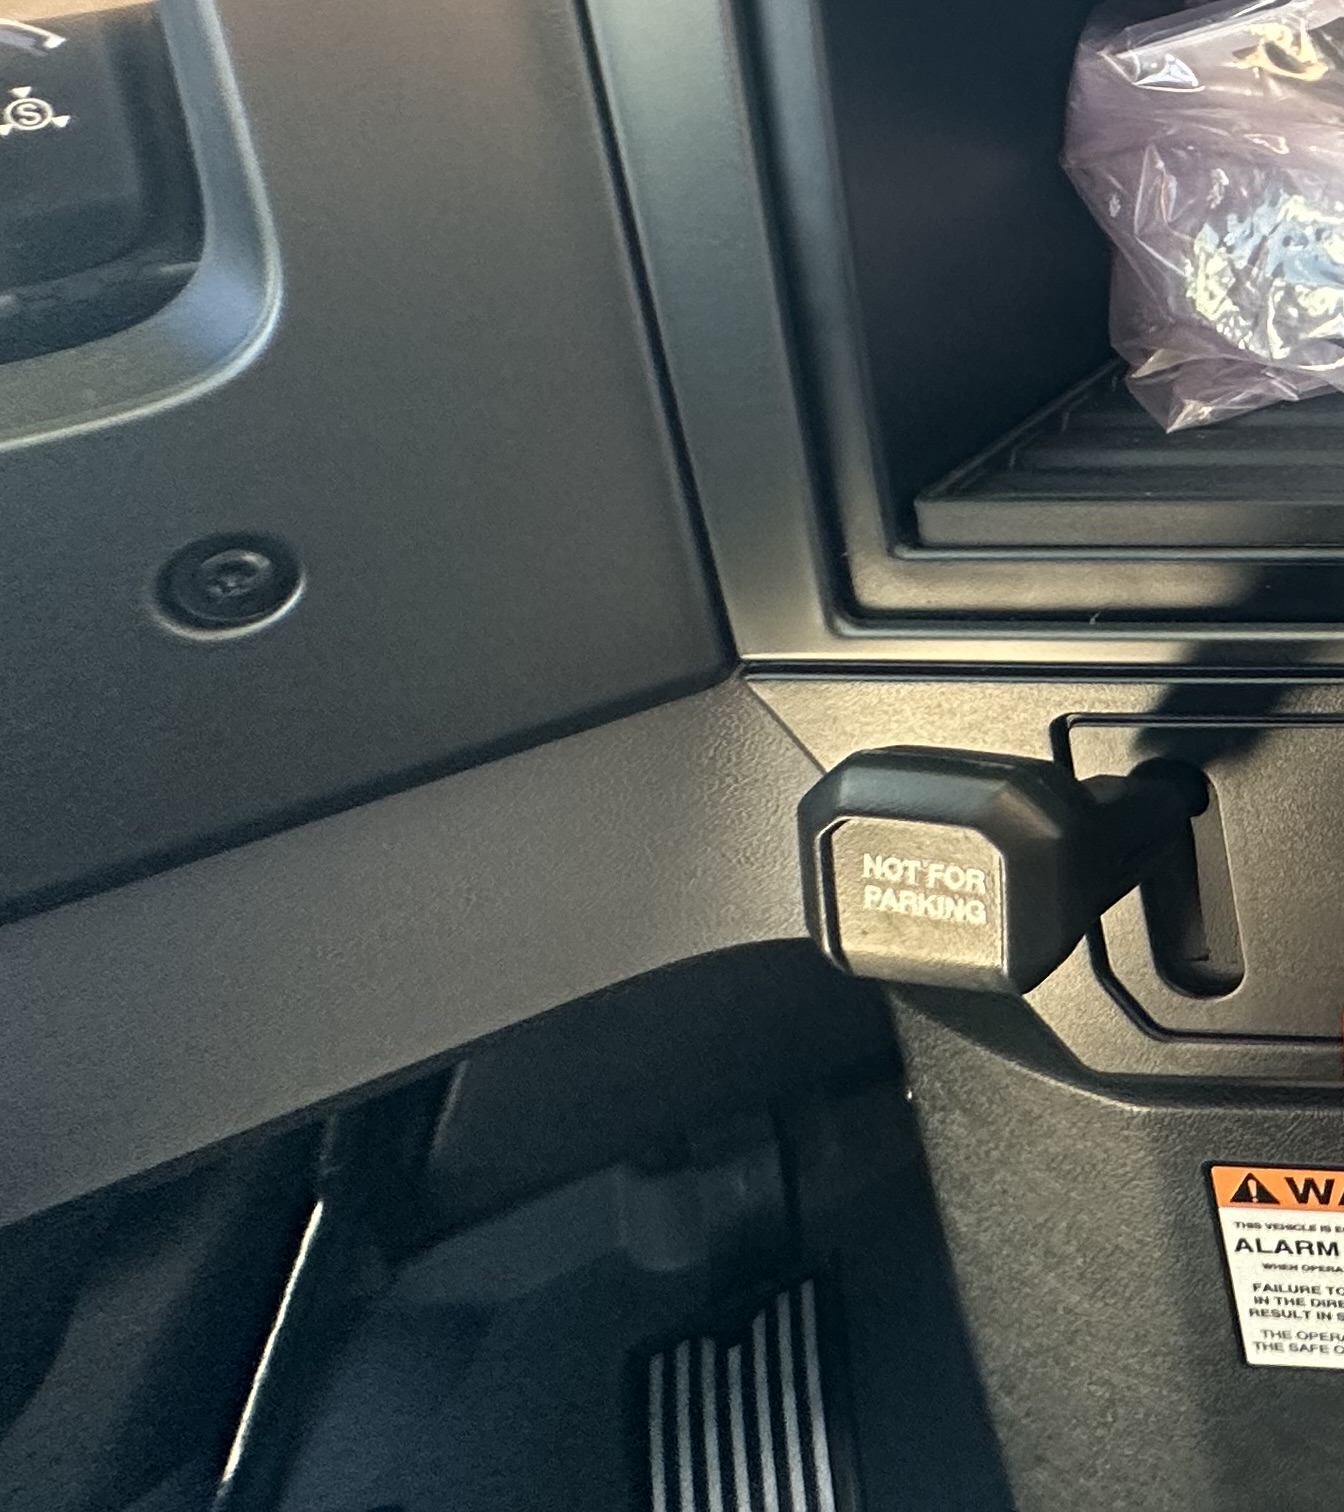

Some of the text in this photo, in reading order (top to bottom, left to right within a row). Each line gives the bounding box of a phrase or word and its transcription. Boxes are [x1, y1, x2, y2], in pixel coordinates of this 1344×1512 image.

[861, 853, 987, 895] NOT FOR
[863, 885, 987, 925] PARKING
[1234, 1221, 1262, 1230] THIS
[1265, 1223, 1317, 1232] VEHICLE
[1320, 1225, 1331, 1233] IS
[1234, 1238, 1339, 1256] ALARM
[1262, 1262, 1298, 1271] WHEN
[1253, 1283, 1322, 1295] FAILURE
[1253, 1296, 1269, 1305] IN
[1273, 1296, 1306, 1306] THE
[1249, 1308, 1311, 1320] RESULT
[1316, 1311, 1331, 1320] IN
[1260, 1329, 1292, 1339] THE
[1252, 1341, 1284, 1352] THE
[1289, 1342, 1330, 1354] SAFE
